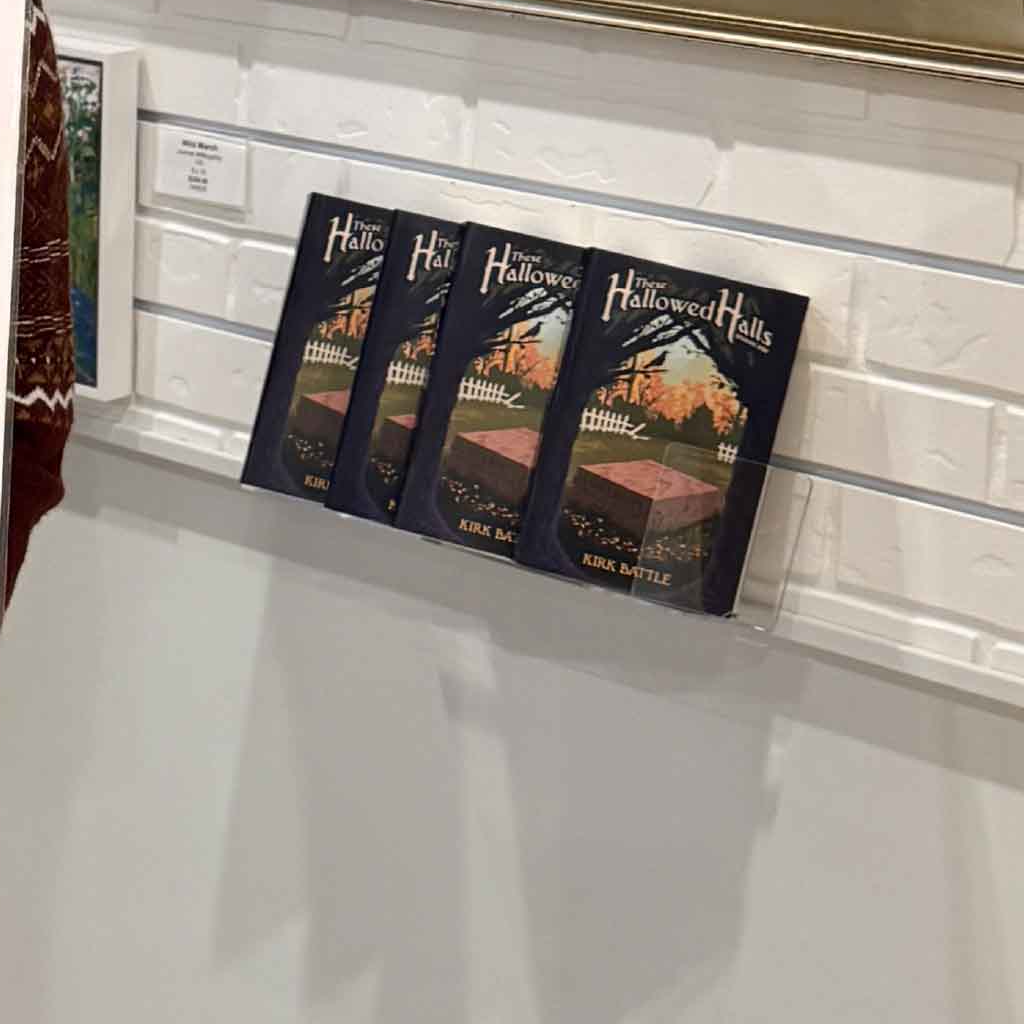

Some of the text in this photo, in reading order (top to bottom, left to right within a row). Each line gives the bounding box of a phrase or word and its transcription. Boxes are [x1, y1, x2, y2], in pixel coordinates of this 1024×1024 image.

[323, 212, 384, 263] Hallo
[405, 229, 451, 282] Hal
[510, 250, 542, 265] These
[634, 277, 668, 289] These
[601, 268, 774, 347] Hallowed Halls
[303, 474, 330, 491] KIR
[459, 518, 491, 537] KIRK
[582, 553, 672, 585] KIRK BATTLE
